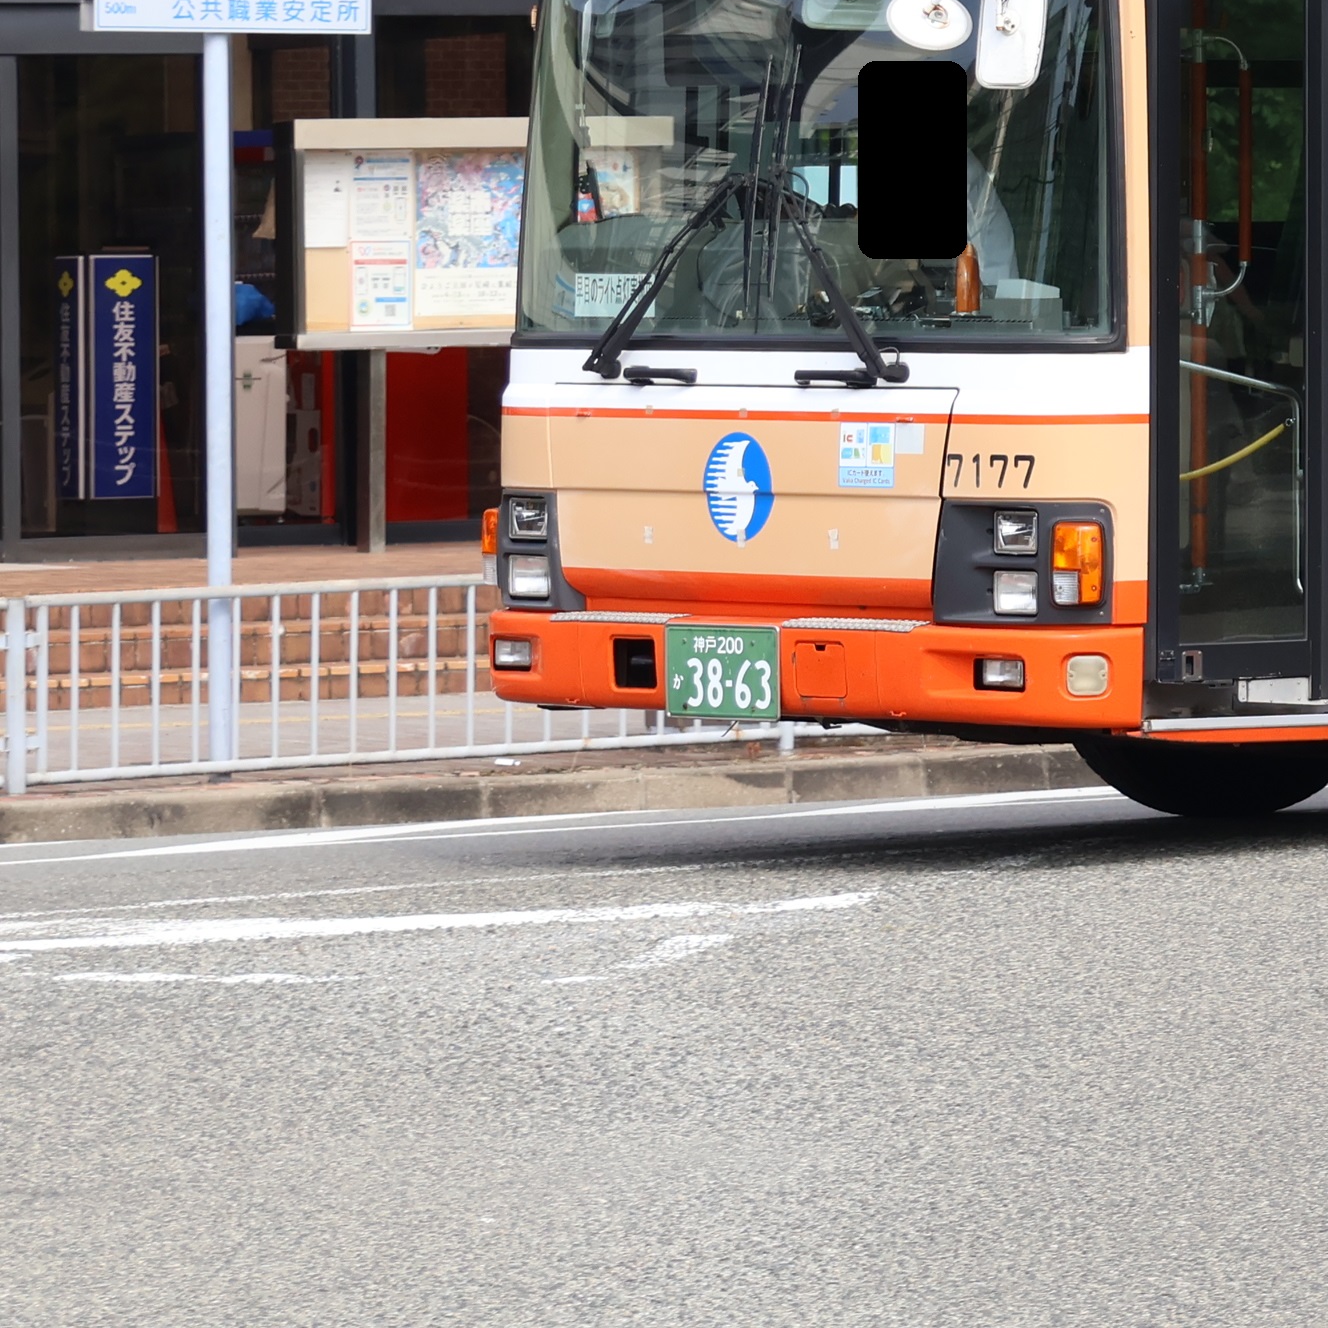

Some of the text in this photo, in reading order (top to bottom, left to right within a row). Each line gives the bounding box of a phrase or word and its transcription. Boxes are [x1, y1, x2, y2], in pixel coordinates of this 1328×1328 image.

[104, 2, 136, 15] 500m
[112, 301, 137, 486] 住友不動産ステップ
[946, 453, 1036, 489] 7177
[673, 657, 772, 710] か 38-63
